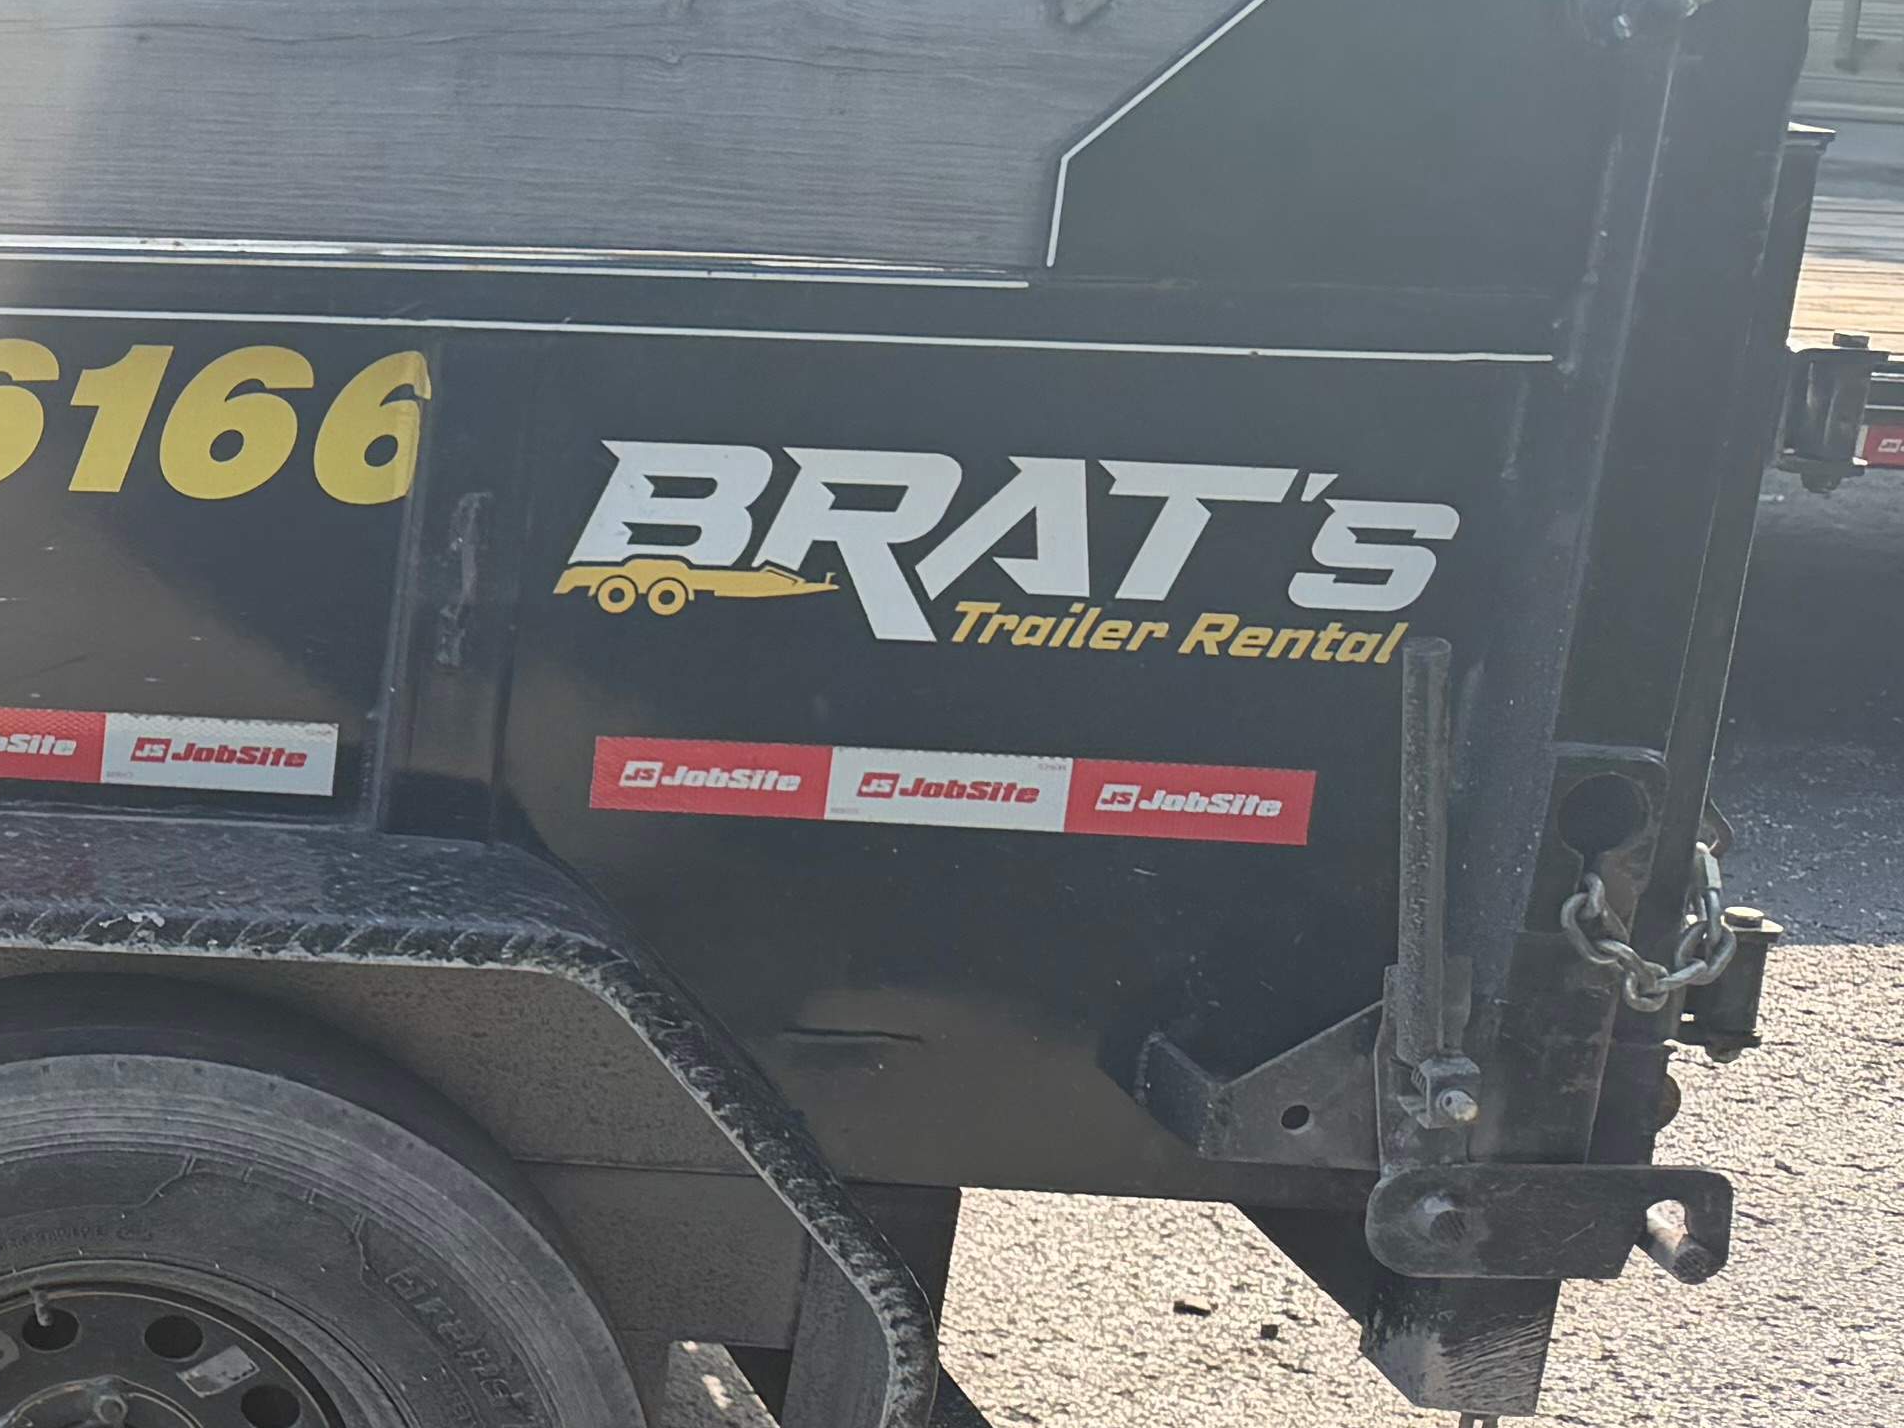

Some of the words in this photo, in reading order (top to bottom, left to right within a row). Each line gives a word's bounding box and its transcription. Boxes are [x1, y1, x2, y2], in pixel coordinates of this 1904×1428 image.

[567, 440, 1461, 642] BRAT's
[950, 600, 1170, 655] Trailer
[1177, 612, 1404, 664] Rental
[173, 743, 307, 768] JobSite
[661, 766, 801, 793] JobSite
[899, 778, 1041, 804] JobSite
[1140, 790, 1282, 818] JobSite
